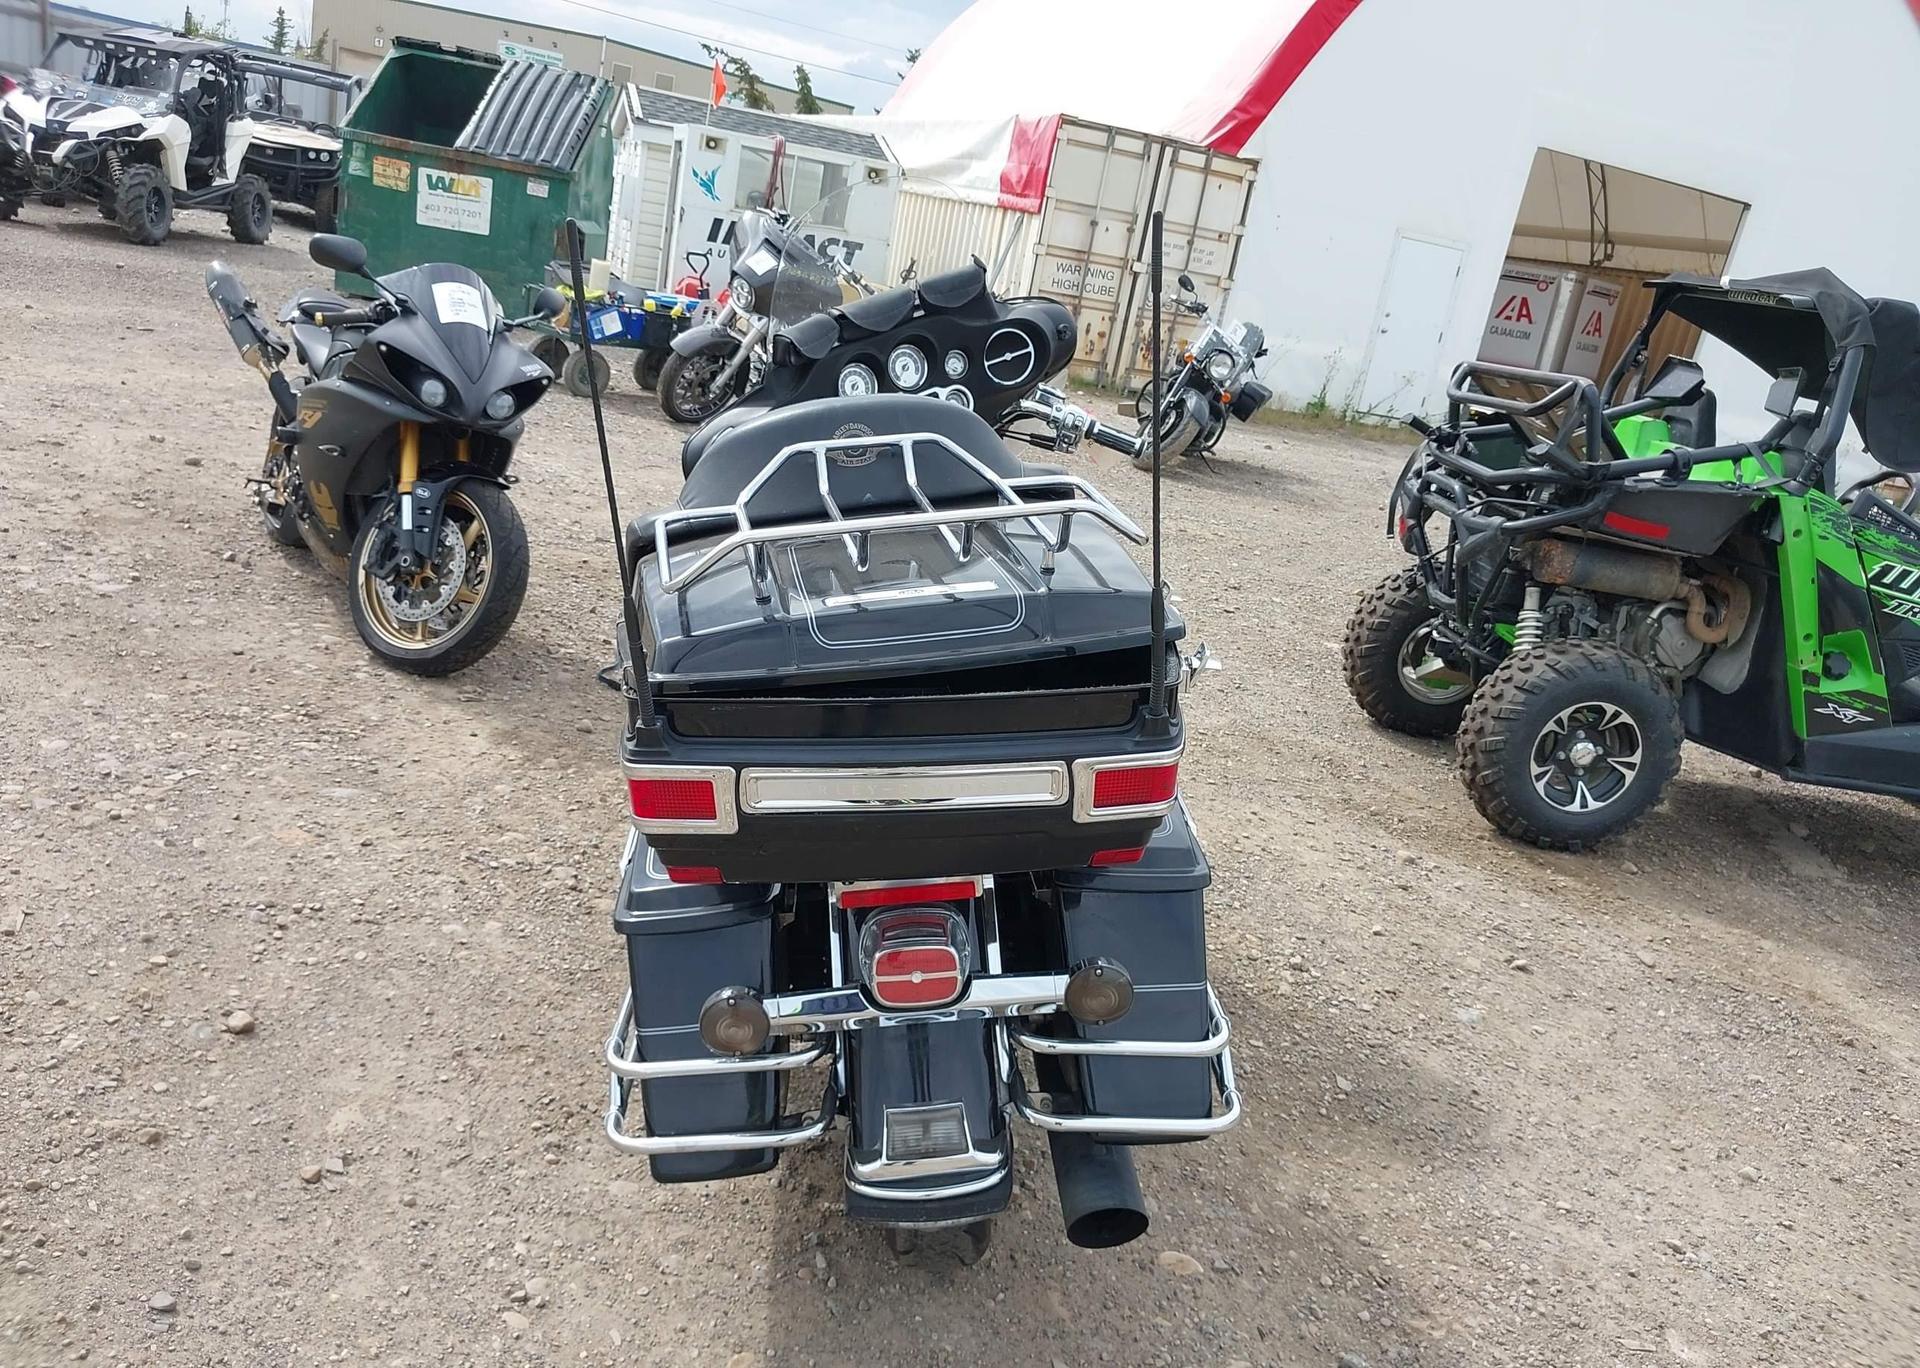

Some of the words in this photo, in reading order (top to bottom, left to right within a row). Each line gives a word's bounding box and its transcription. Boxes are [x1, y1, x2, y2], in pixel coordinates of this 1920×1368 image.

[443, 206, 459, 216] 720
[1056, 261, 1115, 281] WARNING
[1051, 277, 1080, 292] HIGH
[1084, 283, 1116, 297] CUBE
